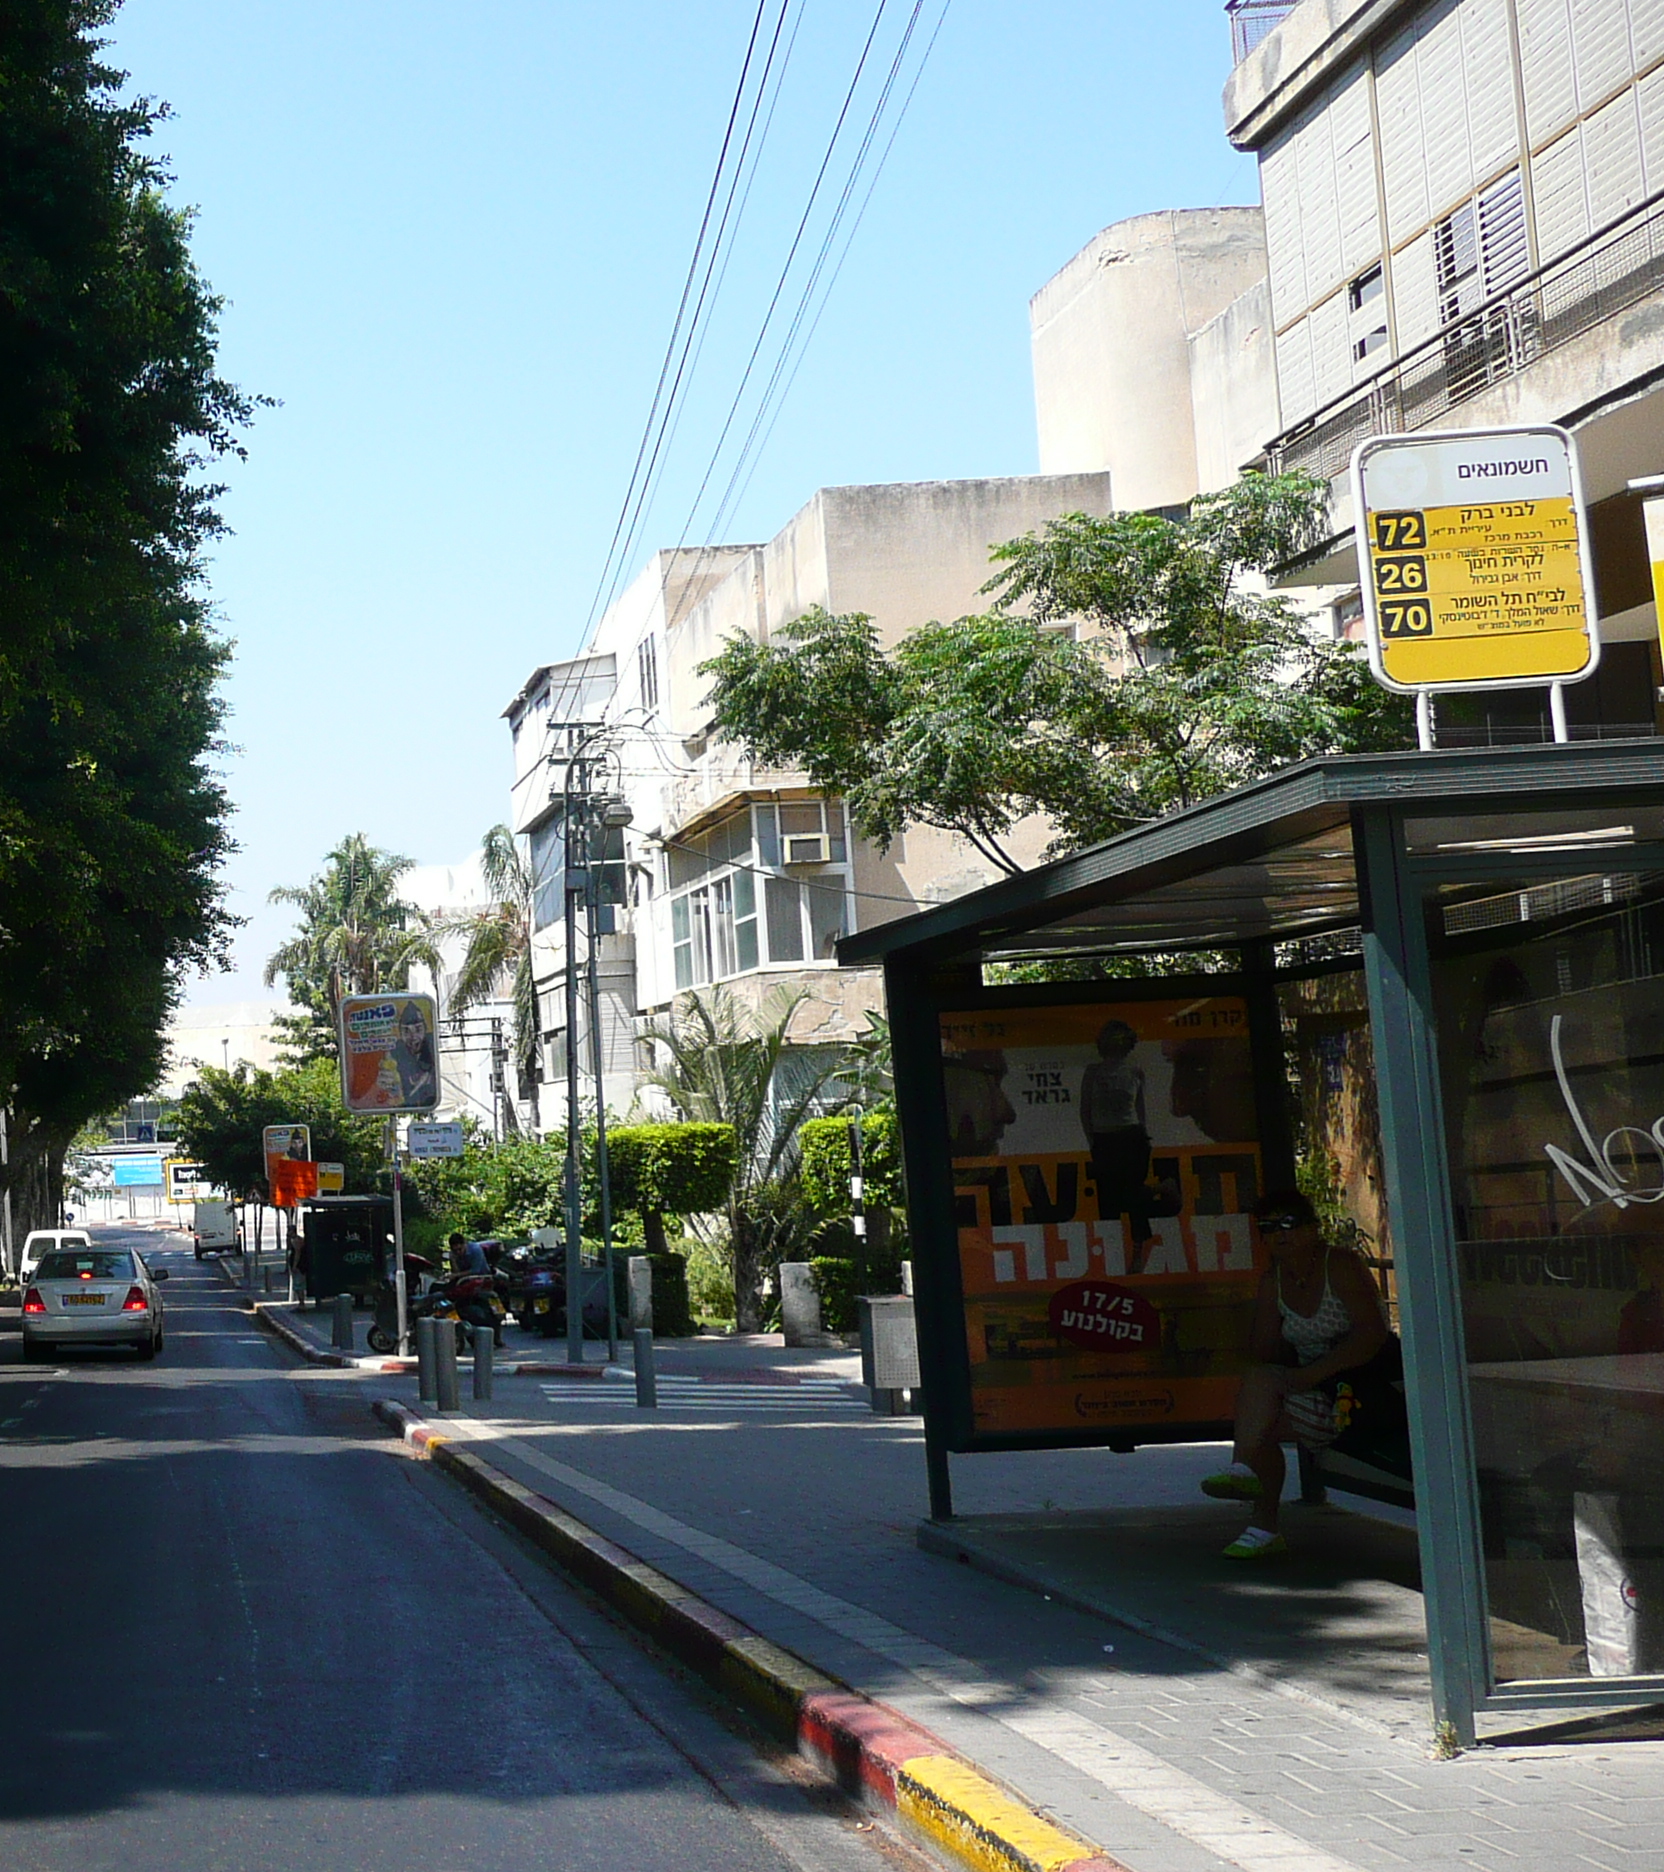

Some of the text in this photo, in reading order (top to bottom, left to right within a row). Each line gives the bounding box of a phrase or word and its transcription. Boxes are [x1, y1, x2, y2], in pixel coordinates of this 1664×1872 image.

[1457, 457, 1548, 480] חשמונאים
[1460, 501, 1535, 524] לבני ברק
[1379, 517, 1421, 546] 72
[1484, 530, 1543, 543] רכבת מרכז
[1464, 551, 1544, 573] לקרית חינוך
[1380, 562, 1424, 589] 26
[1469, 573, 1499, 585] גבירול
[1501, 572, 1519, 585] אבן
[1450, 594, 1498, 609] השומר
[1500, 590, 1523, 605] תל
[1384, 605, 1428, 632] 70
[1533, 605, 1559, 616] שאול
[1534, 617, 1545, 627] לא
[1209, 1009, 1242, 1029] קרן
[1027, 1072, 1062, 1088] צחי
[1021, 1088, 1071, 1105] גראד
[991, 1212, 1254, 1283] מגונה
[1080, 1288, 1136, 1316] 17/5
[1059, 1307, 1146, 1343] בקולנוע
